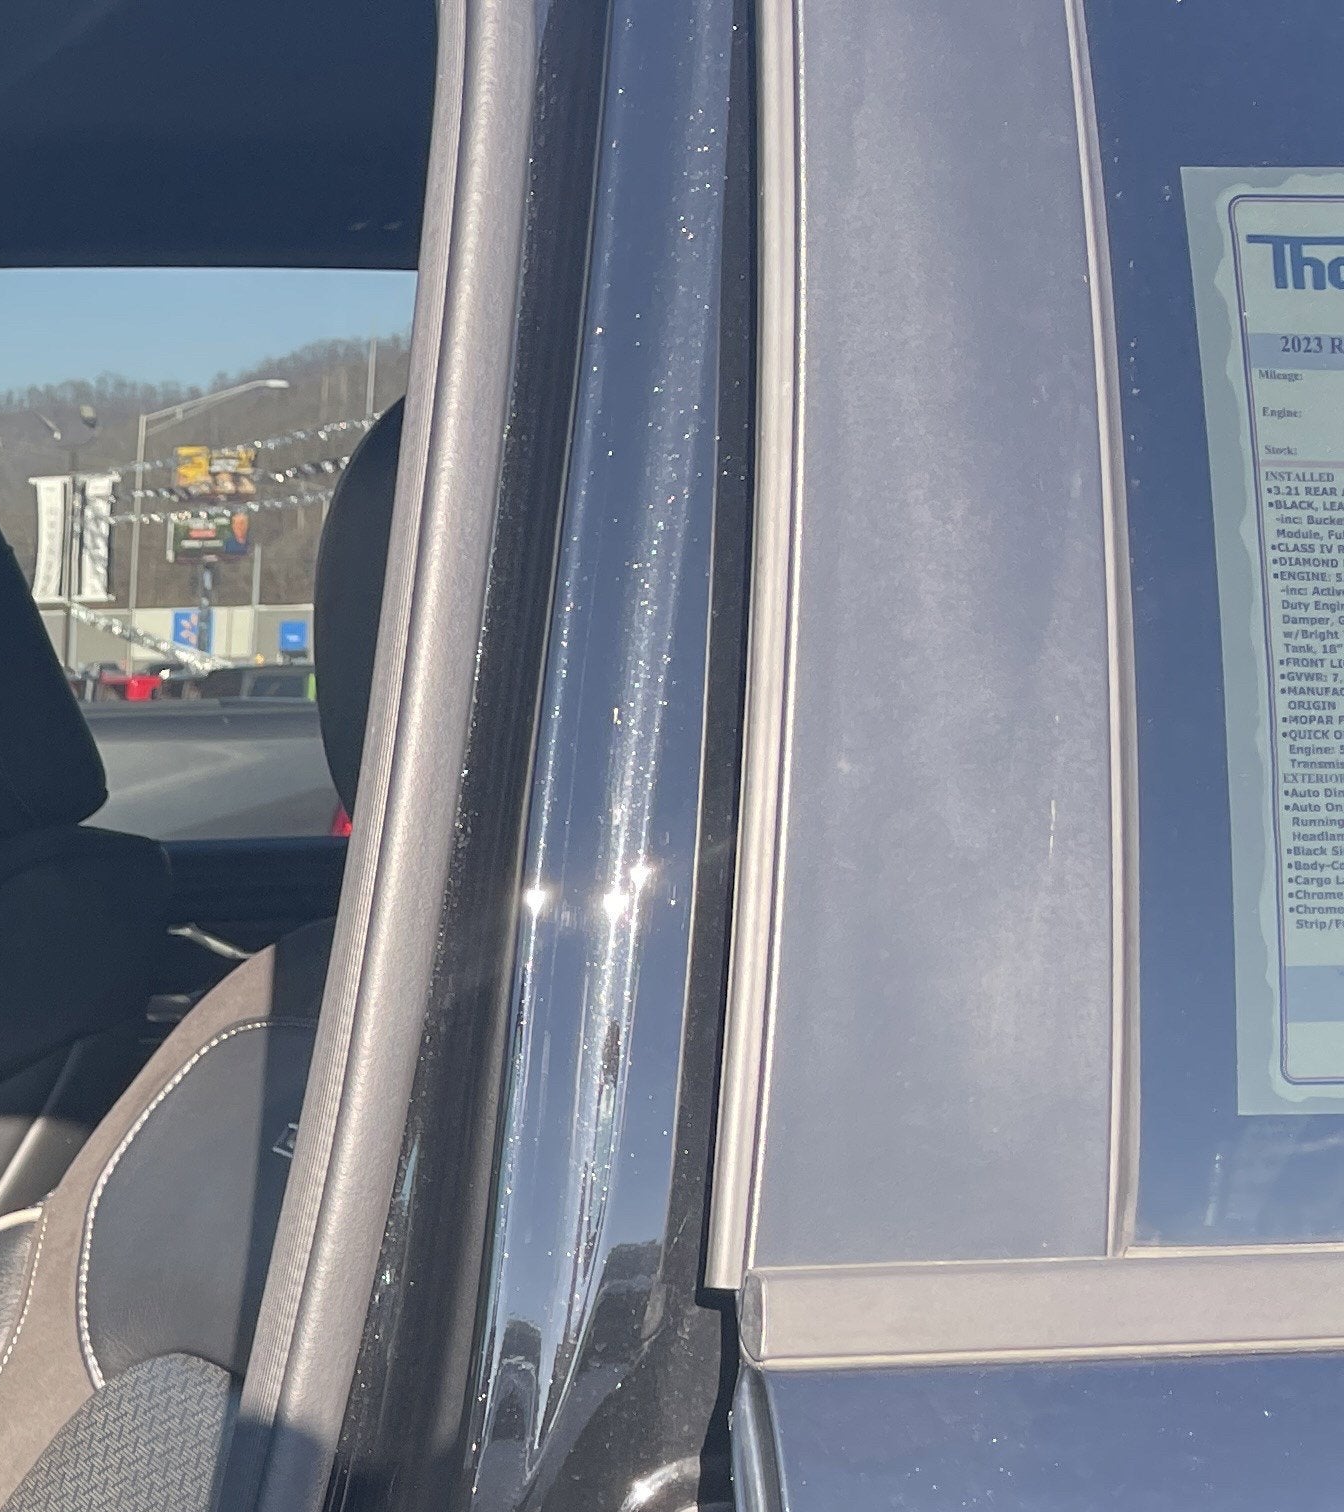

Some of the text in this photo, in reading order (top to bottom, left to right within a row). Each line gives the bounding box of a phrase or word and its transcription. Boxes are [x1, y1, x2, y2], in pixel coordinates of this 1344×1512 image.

[1280, 336, 1323, 353] 2023
[1258, 369, 1303, 382] Mileage:
[1262, 406, 1302, 420] Engine:
[1265, 445, 1297, 455] Stock:
[1265, 471, 1335, 482] INSTALLED
[1305, 486, 1337, 496] REAR
[1277, 528, 1324, 541] Module,
[1277, 543, 1316, 553] CLASS
[1320, 544, 1334, 553] IV
[1279, 557, 1339, 568] DIAMOND
[1282, 600, 1311, 612] Duty
[1283, 615, 1333, 627] Damper,
[1283, 630, 1340, 641] w/Bright
[1284, 643, 1317, 654] Tank,
[1286, 658, 1344, 668] FRONT LI
[1288, 701, 1336, 710] ORIGIN
[1289, 715, 1333, 725] MOPAR
[1289, 730, 1329, 741] QUICK
[1290, 745, 1334, 756] Engine:
[1291, 789, 1320, 798] Auto
[1292, 803, 1343, 812] Auto On
[1292, 817, 1344, 829] Running
[1294, 846, 1327, 856] Black
[1295, 875, 1331, 887] Cargo
[1295, 890, 1343, 900] Chrome
[1296, 905, 1344, 914] Chrome
